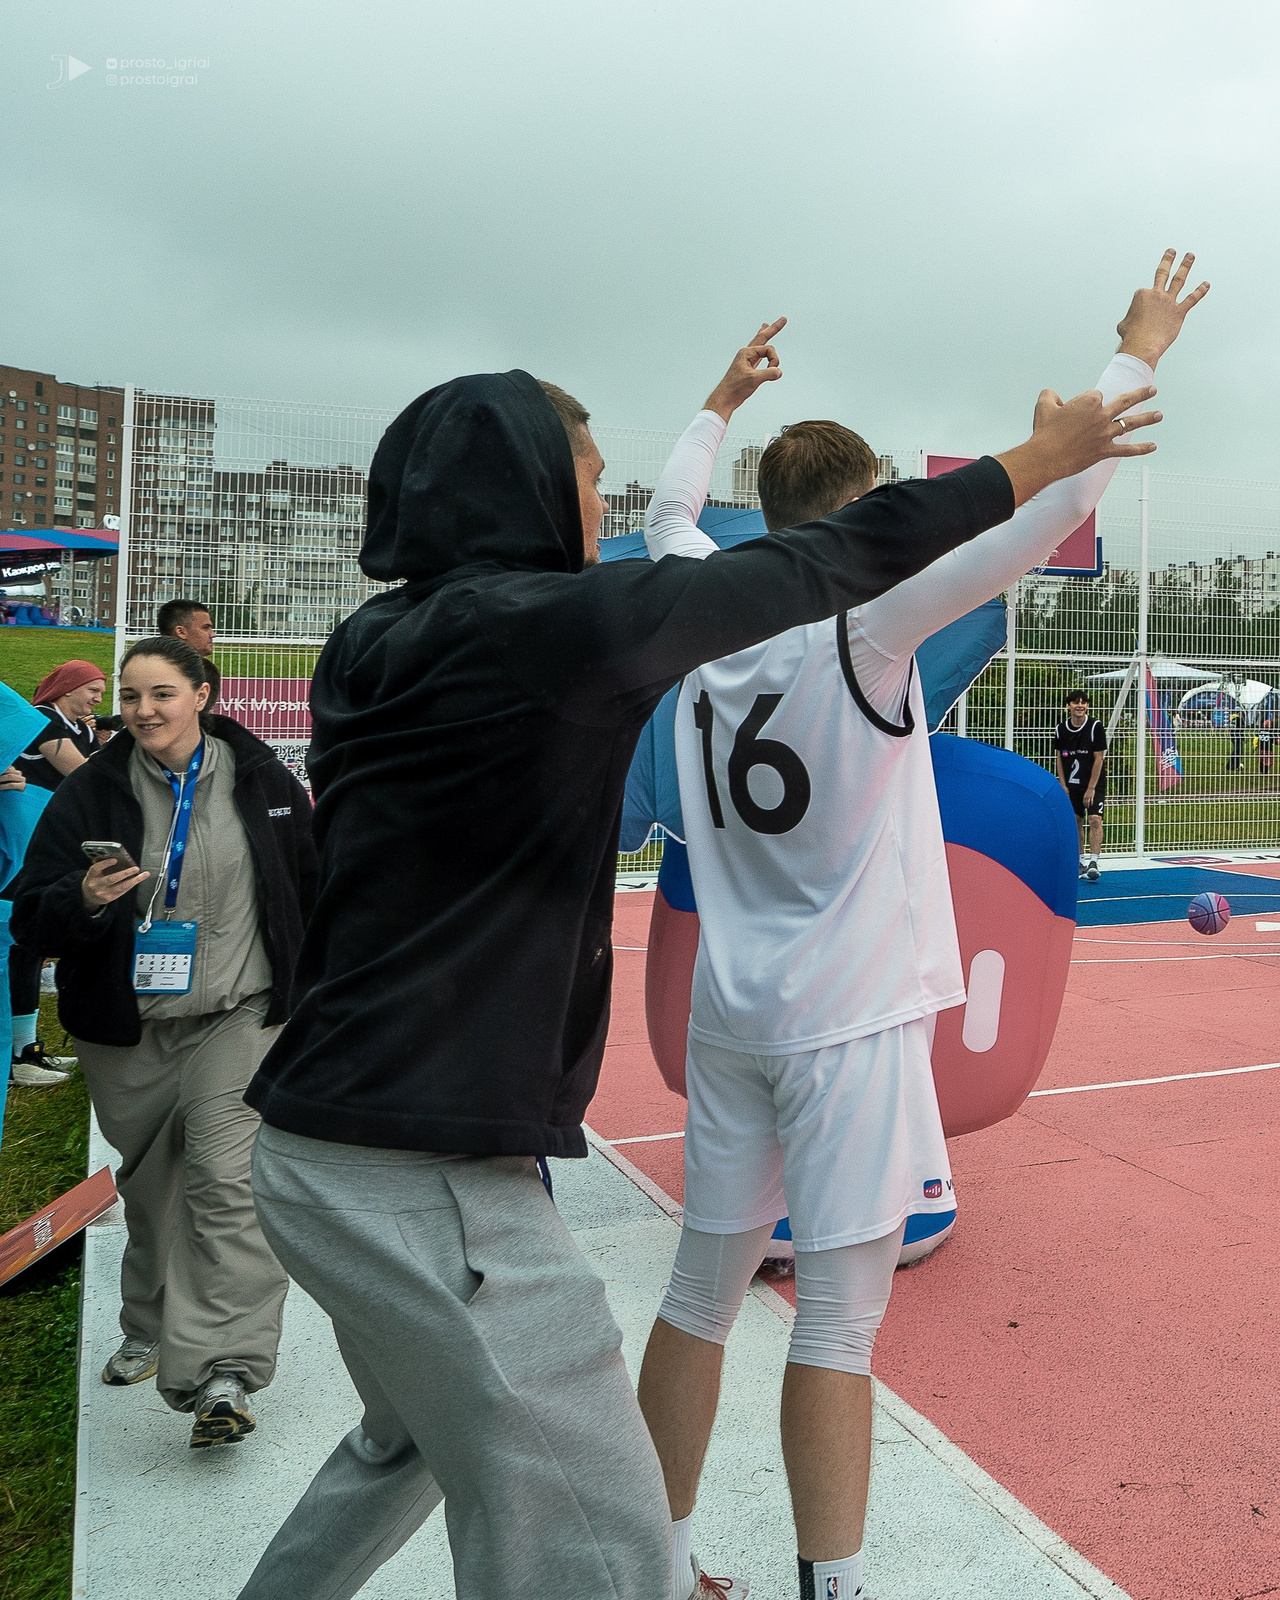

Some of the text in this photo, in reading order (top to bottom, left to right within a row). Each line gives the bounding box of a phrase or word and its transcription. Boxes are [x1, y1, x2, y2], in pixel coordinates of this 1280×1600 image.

[2, 562, 46, 577] Каждое
[220, 698, 247, 711] VK
[692, 689, 812, 835] 16
[1068, 759, 1080, 784] 2
[1098, 802, 1104, 814] 2
